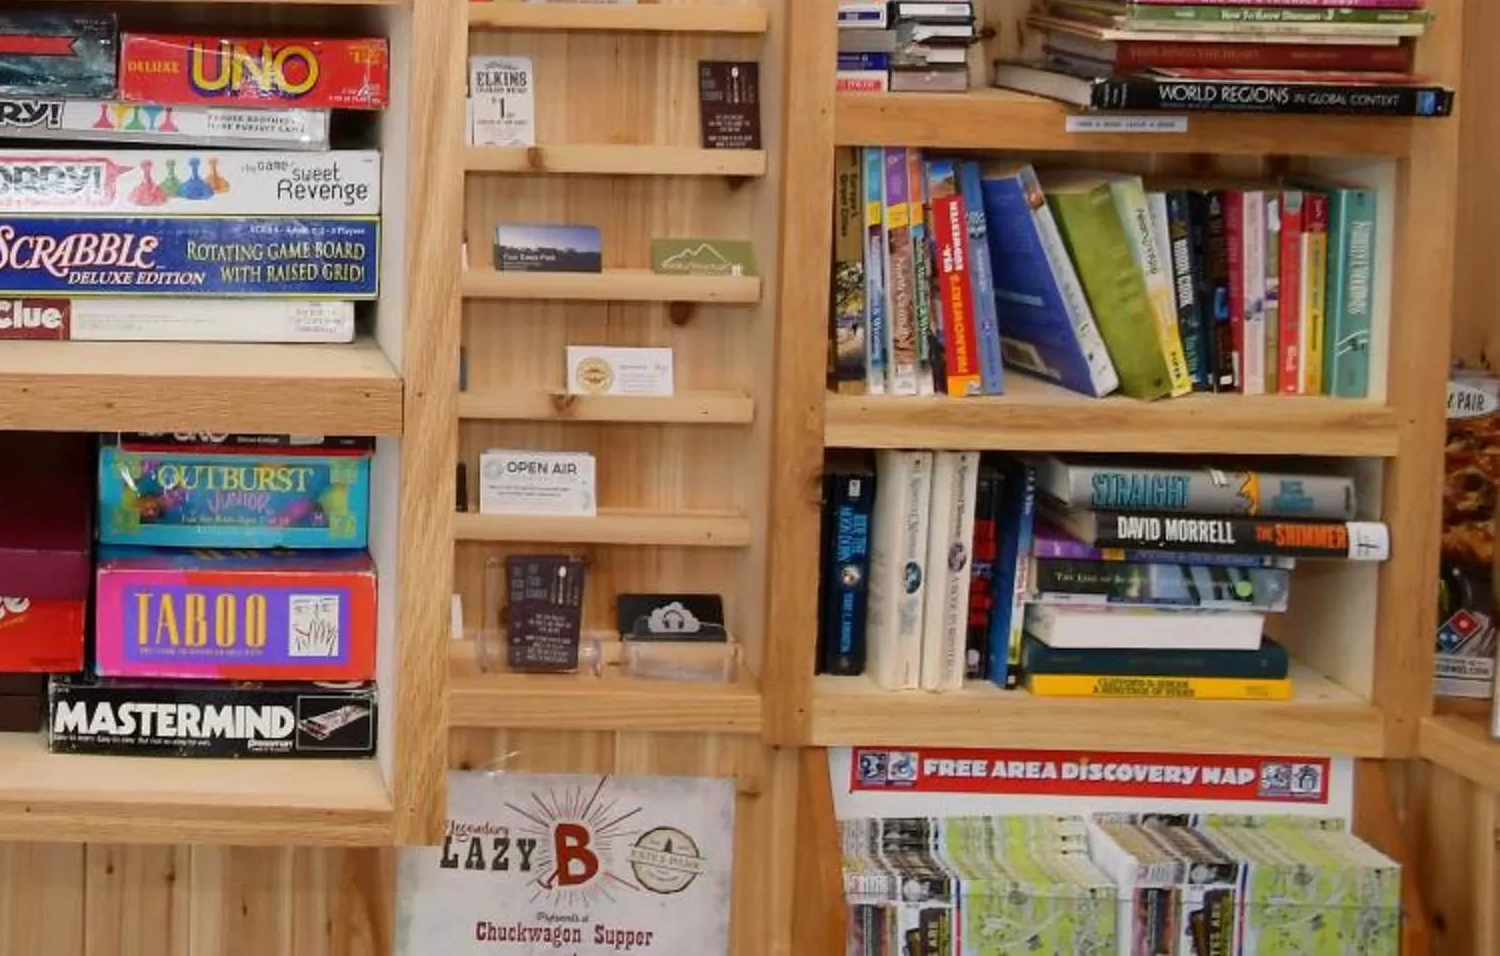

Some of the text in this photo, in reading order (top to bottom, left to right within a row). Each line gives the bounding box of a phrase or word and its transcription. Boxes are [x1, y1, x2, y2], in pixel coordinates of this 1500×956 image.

[127, 40, 321, 95] DELUXE UNO
[1159, 84, 1218, 102] WORLD
[1221, 86, 1289, 105] REGIONS
[1308, 93, 1348, 106] GLOBAL
[276, 179, 369, 206] Revenge
[186, 241, 367, 261] ROTATING GAME BOARD
[67, 270, 207, 285] DELUXE EDITION
[220, 266, 262, 284] WITH
[267, 264, 319, 282] RAISED
[157, 463, 315, 493] OUTBURST
[506, 460, 578, 476] OPEN AIR
[1090, 472, 1192, 509] STRAIGHT
[1117, 515, 1160, 541] DAVID
[1165, 519, 1236, 545] MORRELL
[133, 591, 268, 648] TABOO
[52, 700, 297, 740] MASTERMIND
[923, 758, 1256, 786] FREE AREA DISCOVERY MAP
[440, 834, 537, 873] LAZY
[475, 920, 654, 951] Chuckwagon Supper
